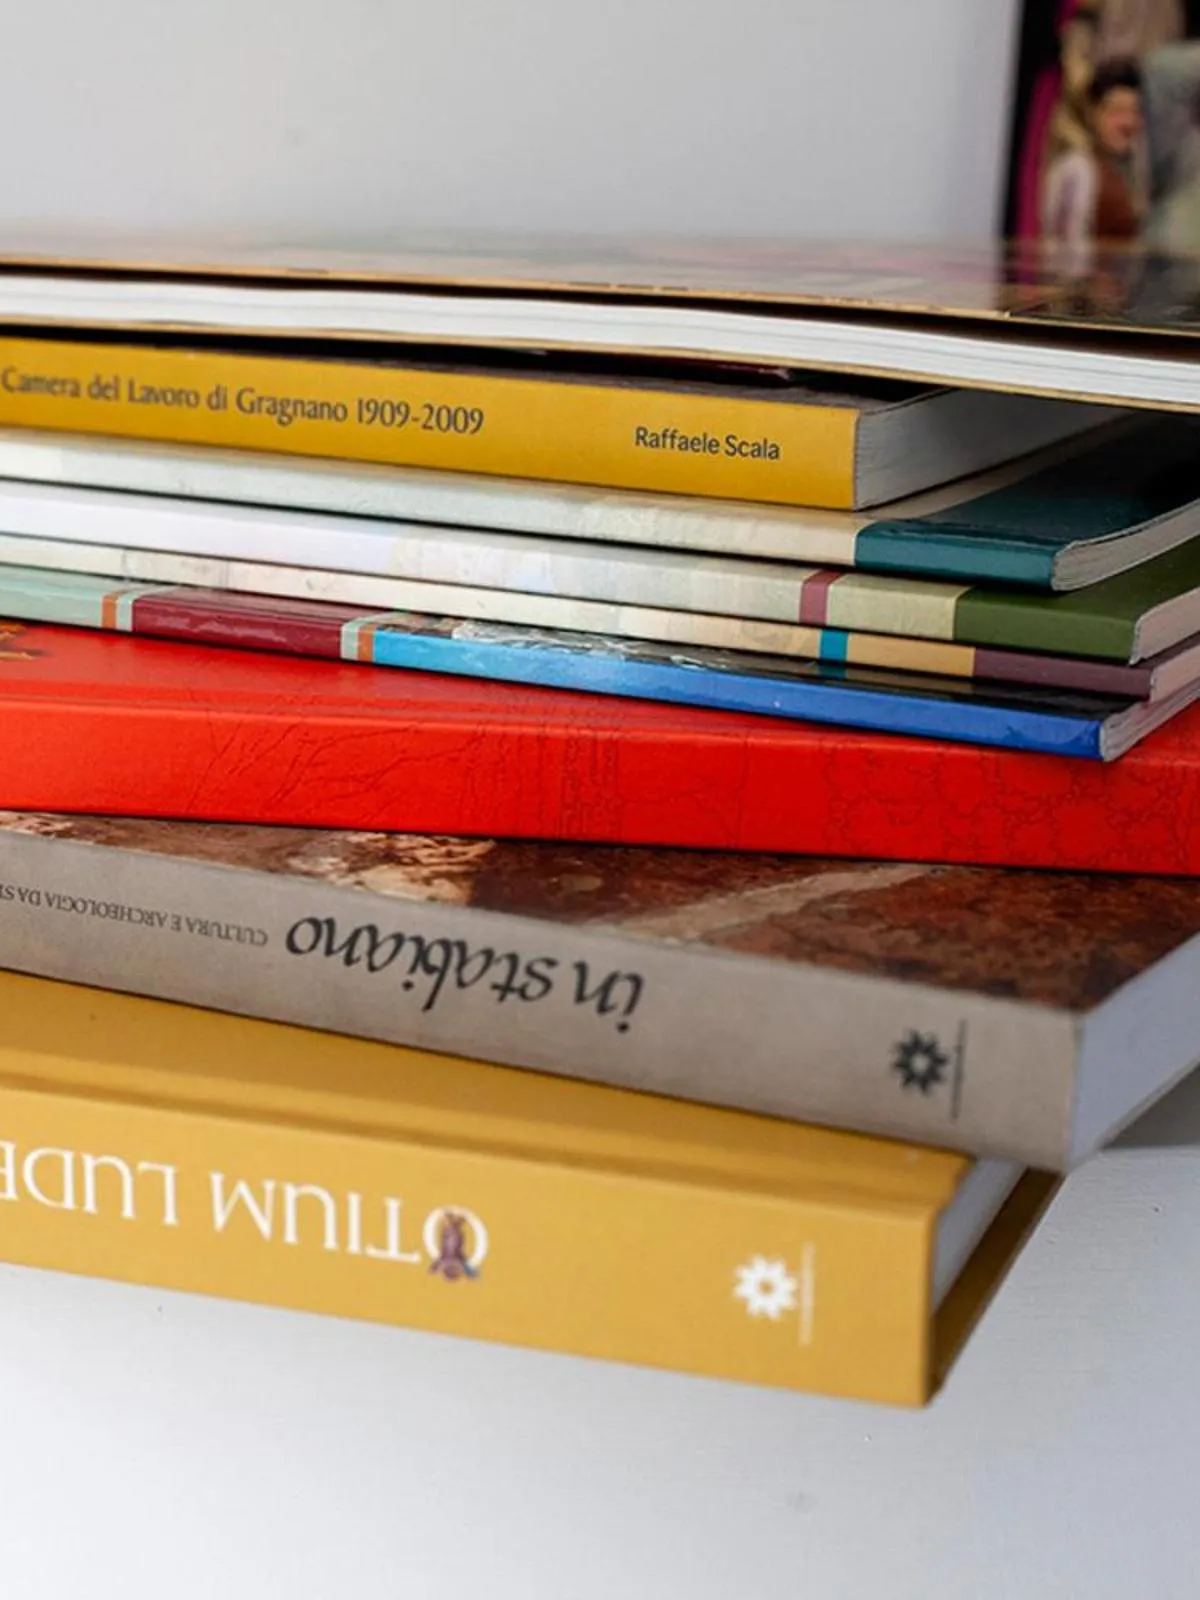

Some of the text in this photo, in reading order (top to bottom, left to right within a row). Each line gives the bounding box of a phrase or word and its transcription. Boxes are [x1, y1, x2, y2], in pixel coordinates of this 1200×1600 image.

[1, 366, 81, 398] Camera
[87, 374, 121, 401] del
[128, 379, 200, 409] Lavoro
[206, 384, 228, 411] di
[235, 387, 349, 427] Gragnano
[356, 397, 485, 435] 1909-2009
[635, 425, 781, 461] Raffaele Scala
[18, 887, 42, 906] DA
[45, 893, 169, 929] ARCHEOLOGIA
[171, 916, 182, 933] E
[185, 919, 268, 947] CULTURA
[285, 916, 645, 1034] in stabiano
[209, 1169, 490, 1277] OTIUM
